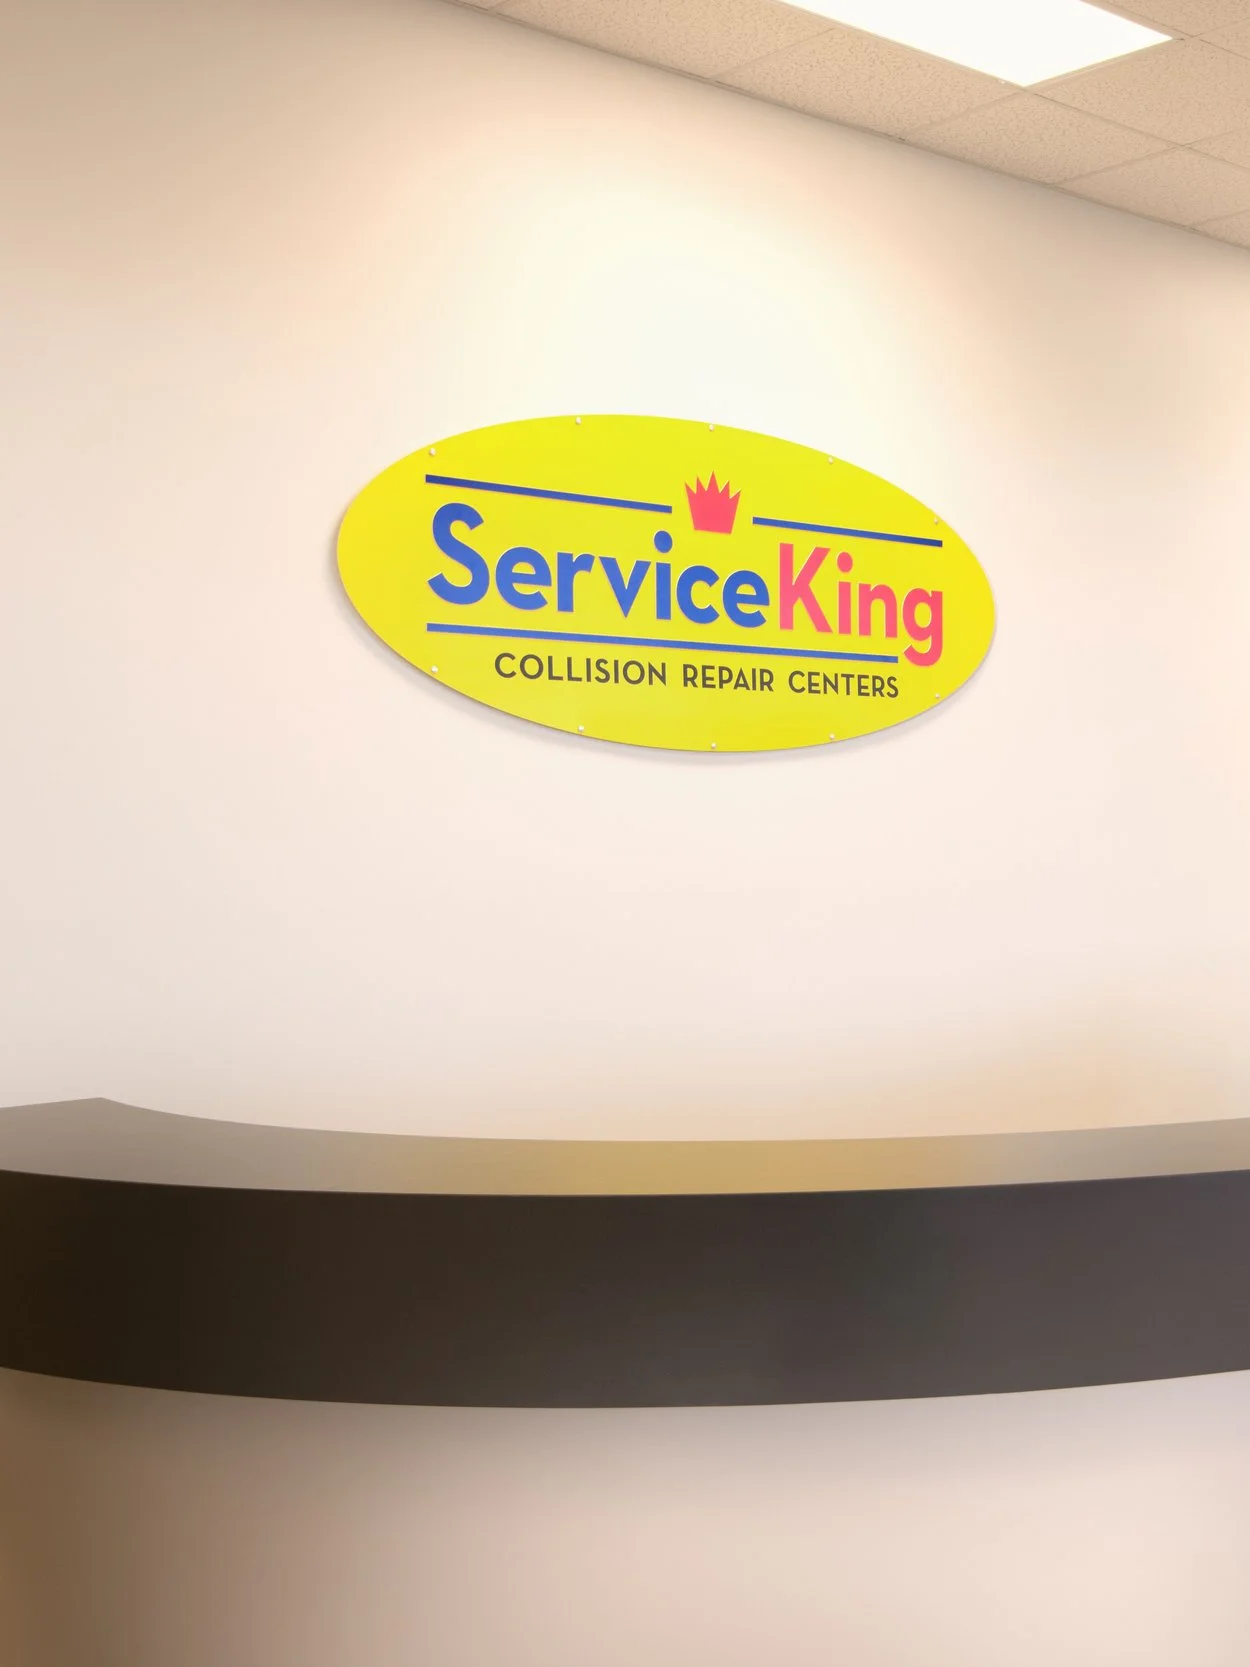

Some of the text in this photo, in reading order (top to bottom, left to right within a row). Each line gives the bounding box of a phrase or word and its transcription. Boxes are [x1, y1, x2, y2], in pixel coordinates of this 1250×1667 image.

[494, 651, 899, 699] COLLISION REPAIR CENTERS
